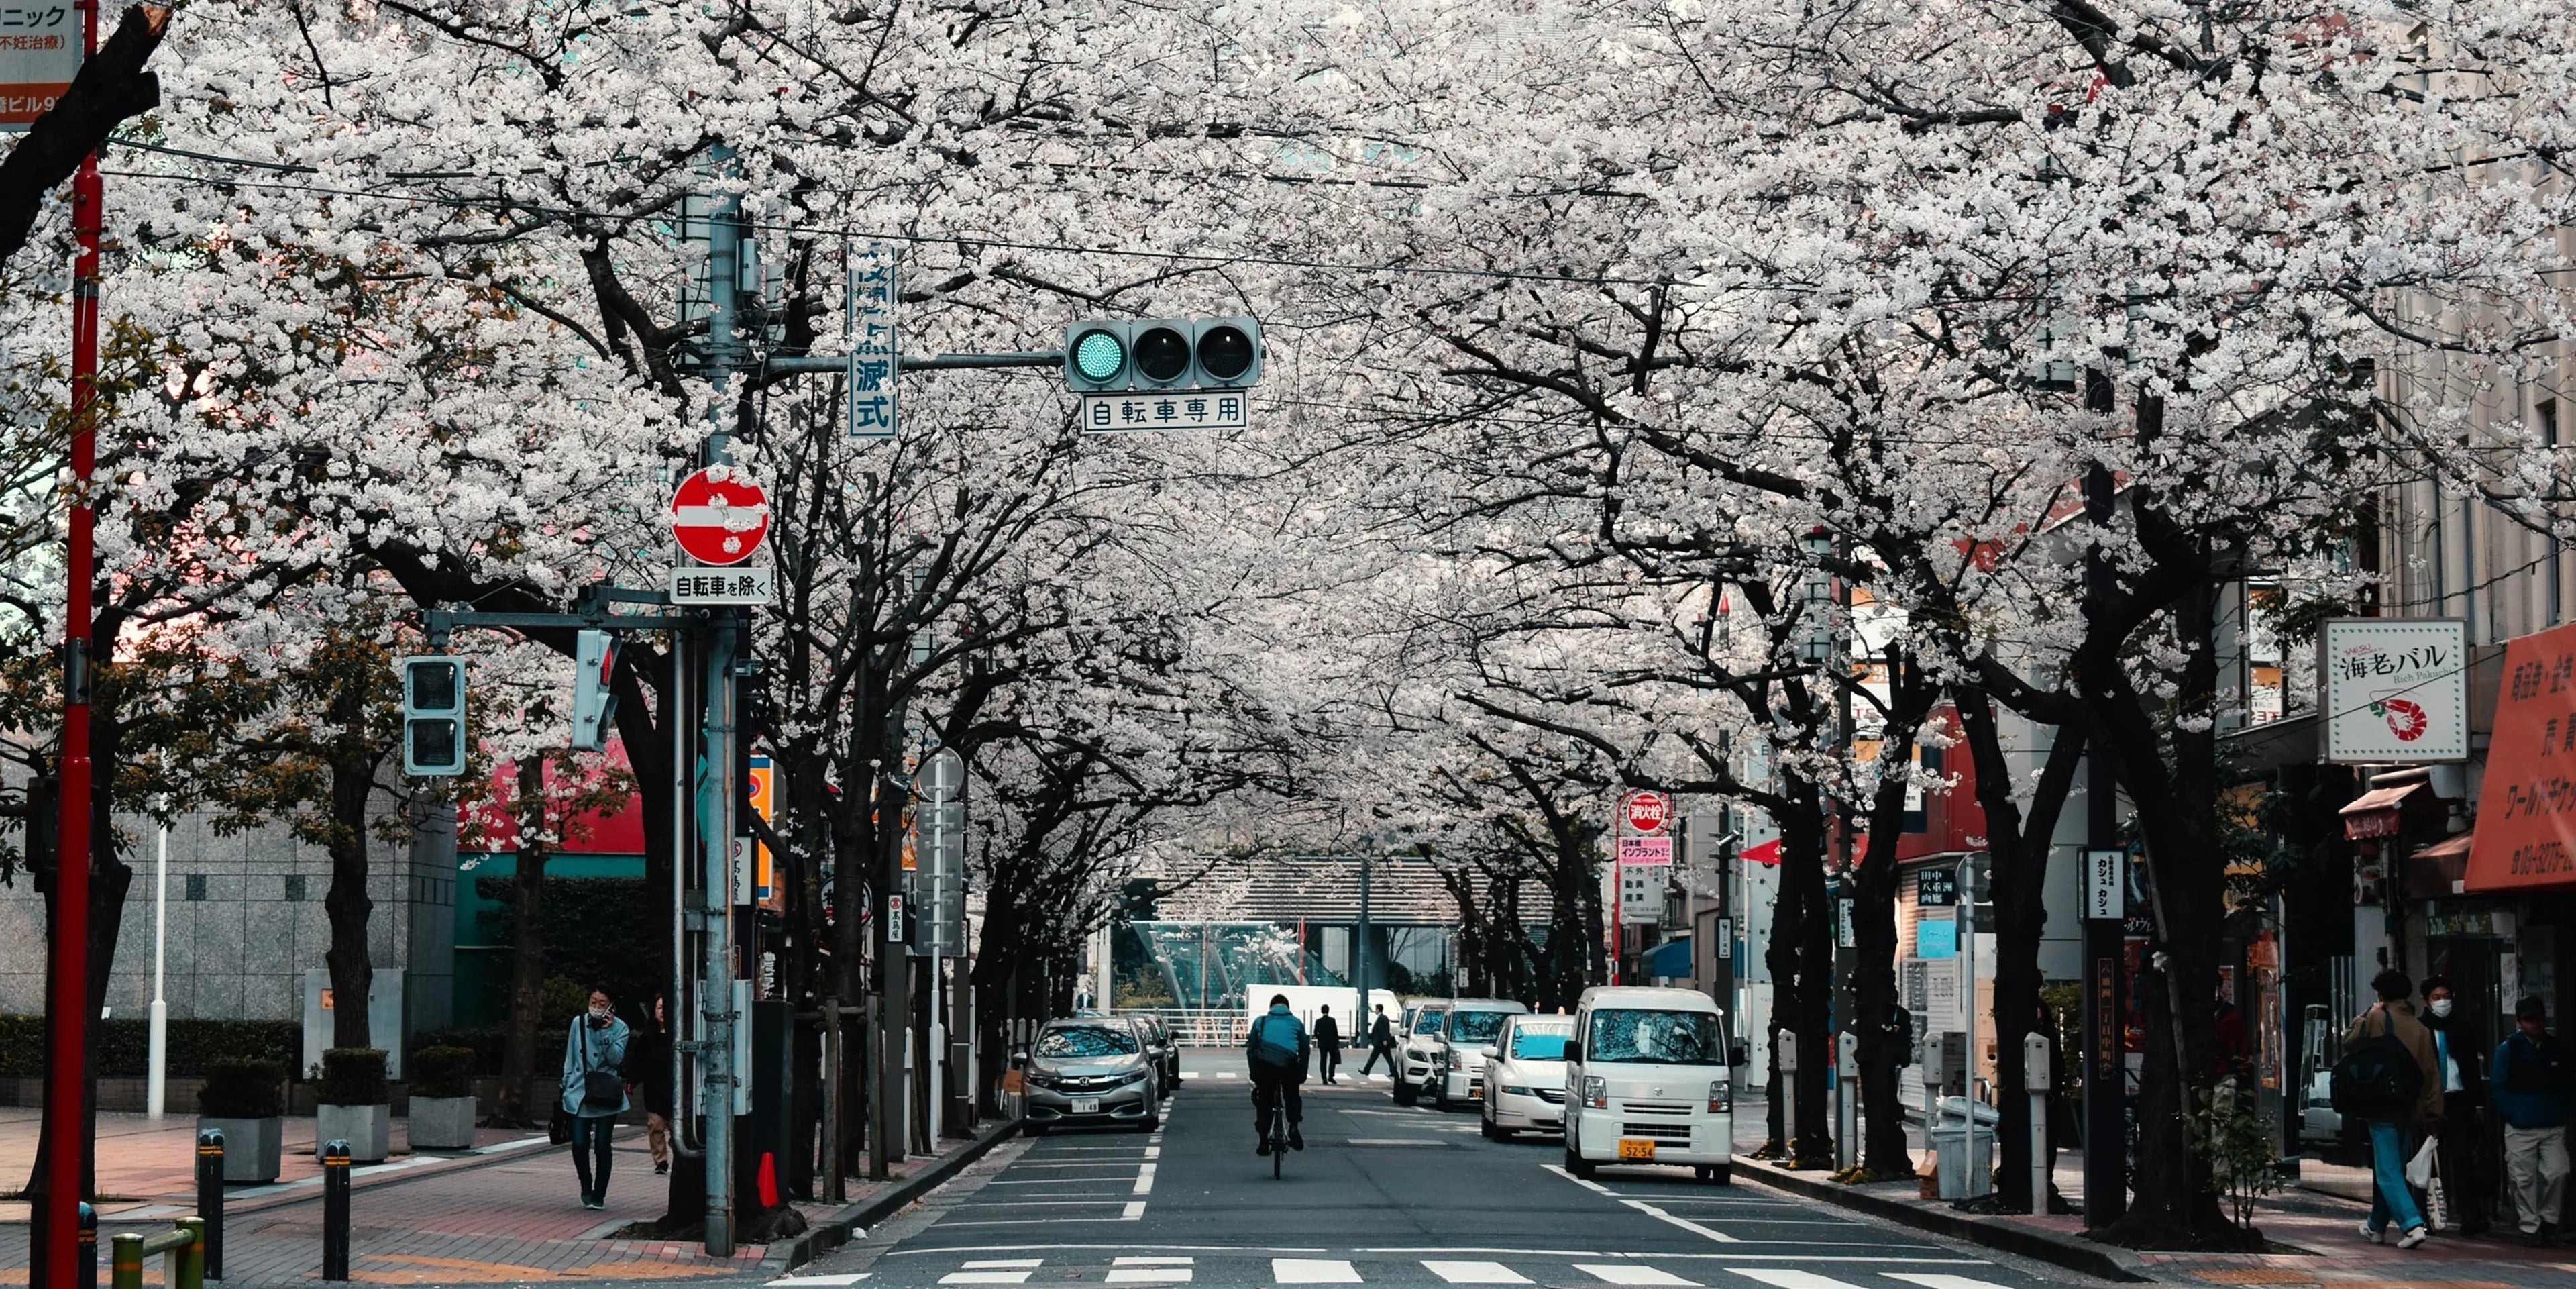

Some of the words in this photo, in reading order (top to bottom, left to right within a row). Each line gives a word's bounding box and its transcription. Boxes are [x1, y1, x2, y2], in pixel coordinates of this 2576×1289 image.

[0, 6, 65, 28] ニック
[0, 95, 60, 114] ビル9
[1093, 397, 1239, 425] 自転車専用
[676, 576, 765, 597] 自転車を除く
[2339, 646, 2447, 681] 海老バル
[2393, 674, 2414, 684] Rich
[2416, 668, 2451, 681] Pakuchi
[1631, 805, 1662, 820] 消火栓
[1622, 848, 1660, 857] インプラント
[1921, 870, 1943, 880] 田中
[2098, 858, 2108, 885] カシュ
[1922, 882, 1953, 892] 八重洲
[2098, 888, 2108, 915] カシュ
[1626, 1146, 1652, 1157] 52-54
